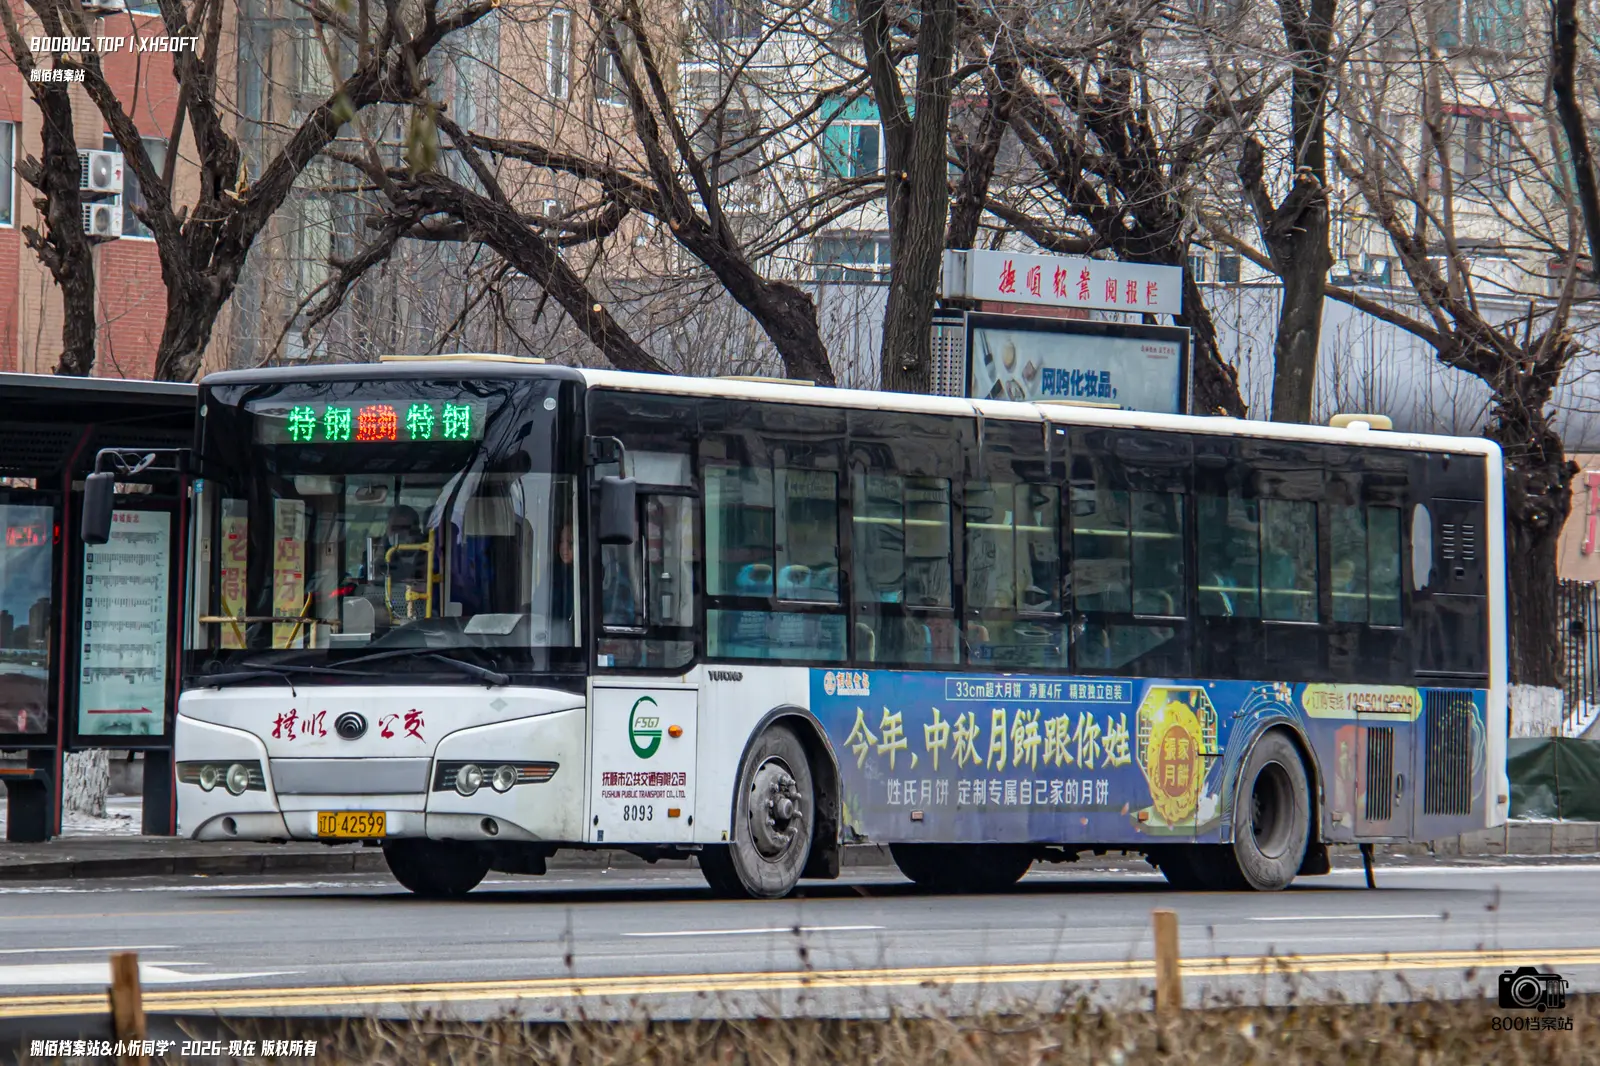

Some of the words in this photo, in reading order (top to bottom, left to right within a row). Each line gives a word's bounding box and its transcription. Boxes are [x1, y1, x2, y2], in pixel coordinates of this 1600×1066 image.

[1041, 367, 1118, 400] 网购化妆品，
[288, 405, 351, 442] 特钢
[406, 403, 471, 440] 特钢
[955, 681, 1021, 699] 33cm超大月饼
[1028, 683, 1062, 699] 净重4斤
[1069, 683, 1123, 701] 精致独立包装
[378, 708, 427, 744] 公交
[602, 771, 687, 787] 抚顺市公共交通有限公司
[886, 778, 949, 806] 姓氏月饼
[957, 779, 1109, 806] 定制专属自己家的月饼
[601, 790, 621, 799] FUSHUN
[622, 790, 638, 799] PUBLIC
[638, 790, 666, 799] TRANSPORT
[623, 804, 654, 822] 8093
